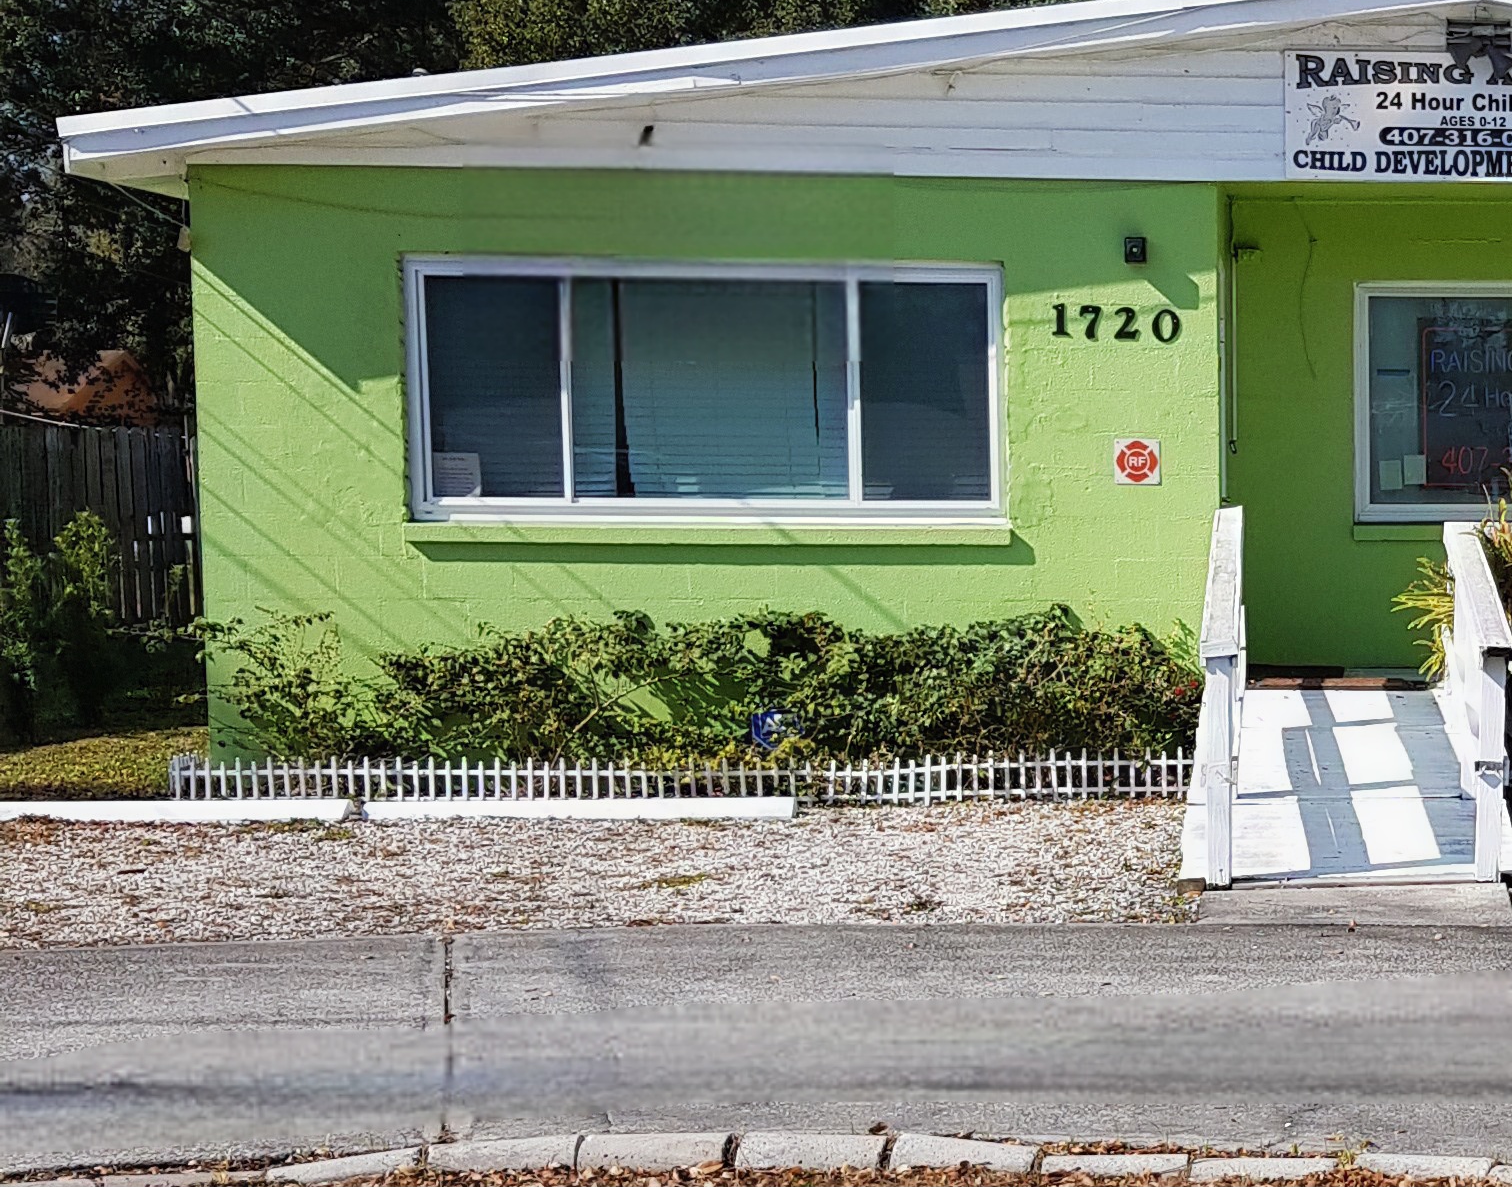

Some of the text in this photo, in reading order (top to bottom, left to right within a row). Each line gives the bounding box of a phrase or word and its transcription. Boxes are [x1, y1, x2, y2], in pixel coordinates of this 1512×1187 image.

[1295, 53, 1475, 89] RAISING
[1376, 92, 1403, 110] 24
[1411, 93, 1466, 112] Hour
[1440, 116, 1507, 128] AGES 0-12
[1293, 150, 1367, 172] CHILD
[1052, 303, 1181, 343] 1720
[1437, 380, 1479, 417] 24
[1128, 457, 1147, 467] RF
